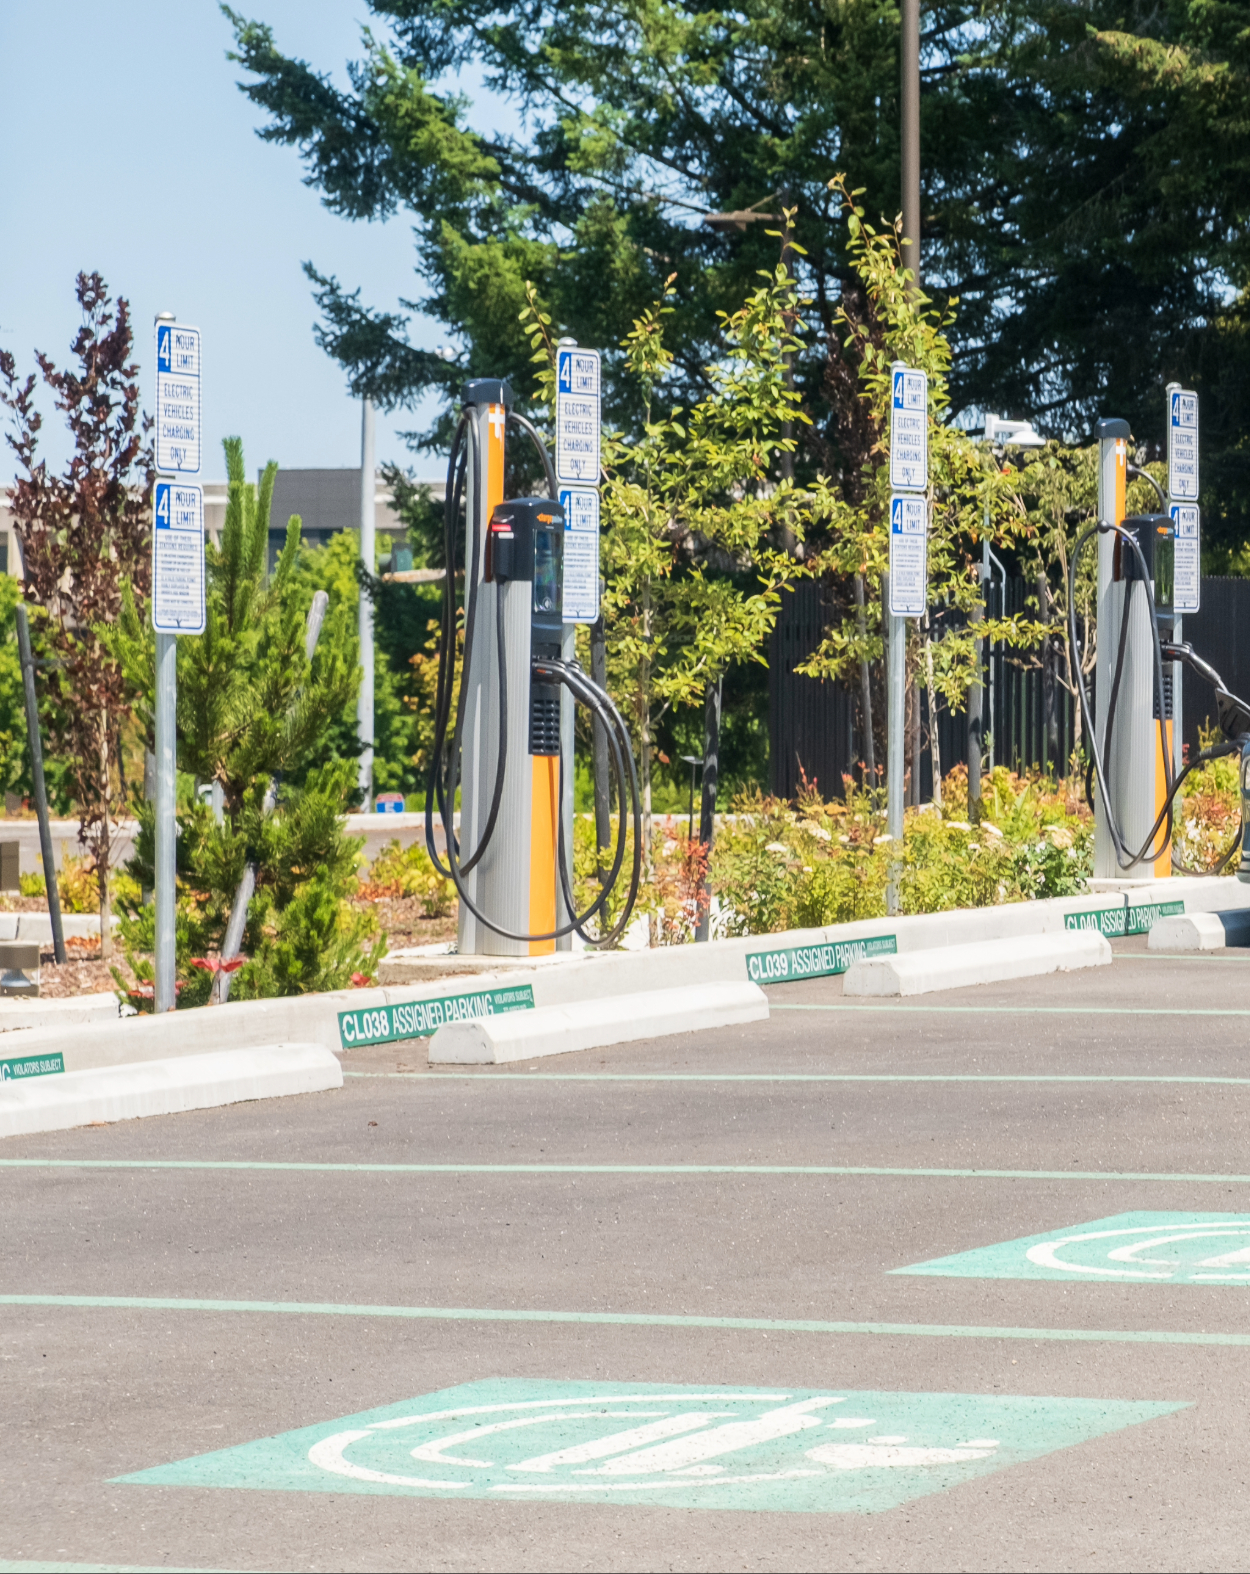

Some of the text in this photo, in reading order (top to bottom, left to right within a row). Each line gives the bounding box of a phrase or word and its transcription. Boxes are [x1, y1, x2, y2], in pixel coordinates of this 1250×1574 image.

[159, 331, 170, 367] 4
[175, 334, 195, 350] HOUR
[176, 353, 194, 369] LIMIT
[576, 359, 594, 373] HOUR
[560, 356, 570, 388] 4
[576, 375, 593, 389] LIMIT
[894, 375, 903, 404] 4
[164, 383, 193, 400] ELECTRIC
[907, 393, 921, 405] LIMIT
[163, 403, 193, 420] VEHICLES
[564, 402, 592, 416] ELECTRIC
[1173, 397, 1179, 422] 4
[564, 421, 593, 435] VEHICLES
[898, 417, 920, 429] ELECTRIC
[163, 424, 194, 440] CHARGING
[897, 433, 920, 446] VEHICLES
[170, 446, 187, 462] ONLY
[563, 439, 593, 453] CHARGING
[570, 458, 586, 471] ONLY
[158, 488, 169, 525] 4
[176, 491, 196, 507] HOUR
[575, 497, 592, 511] HOUR
[176, 511, 195, 525] LIMIT
[564, 494, 571, 526] 4
[893, 502, 901, 531] 4
[576, 513, 592, 527] LIMIT
[906, 519, 920, 531] LIMIT
[1101, 908, 1136, 933] ASSIGND
[749, 953, 788, 980] CL039
[792, 945, 836, 975] ASSIGNED
[342, 993, 494, 1042] CL038 ASSIGNED PARKING
[13, 1061, 39, 1076] VIOLATORS
[40, 1058, 61, 1073] SUBJECT
